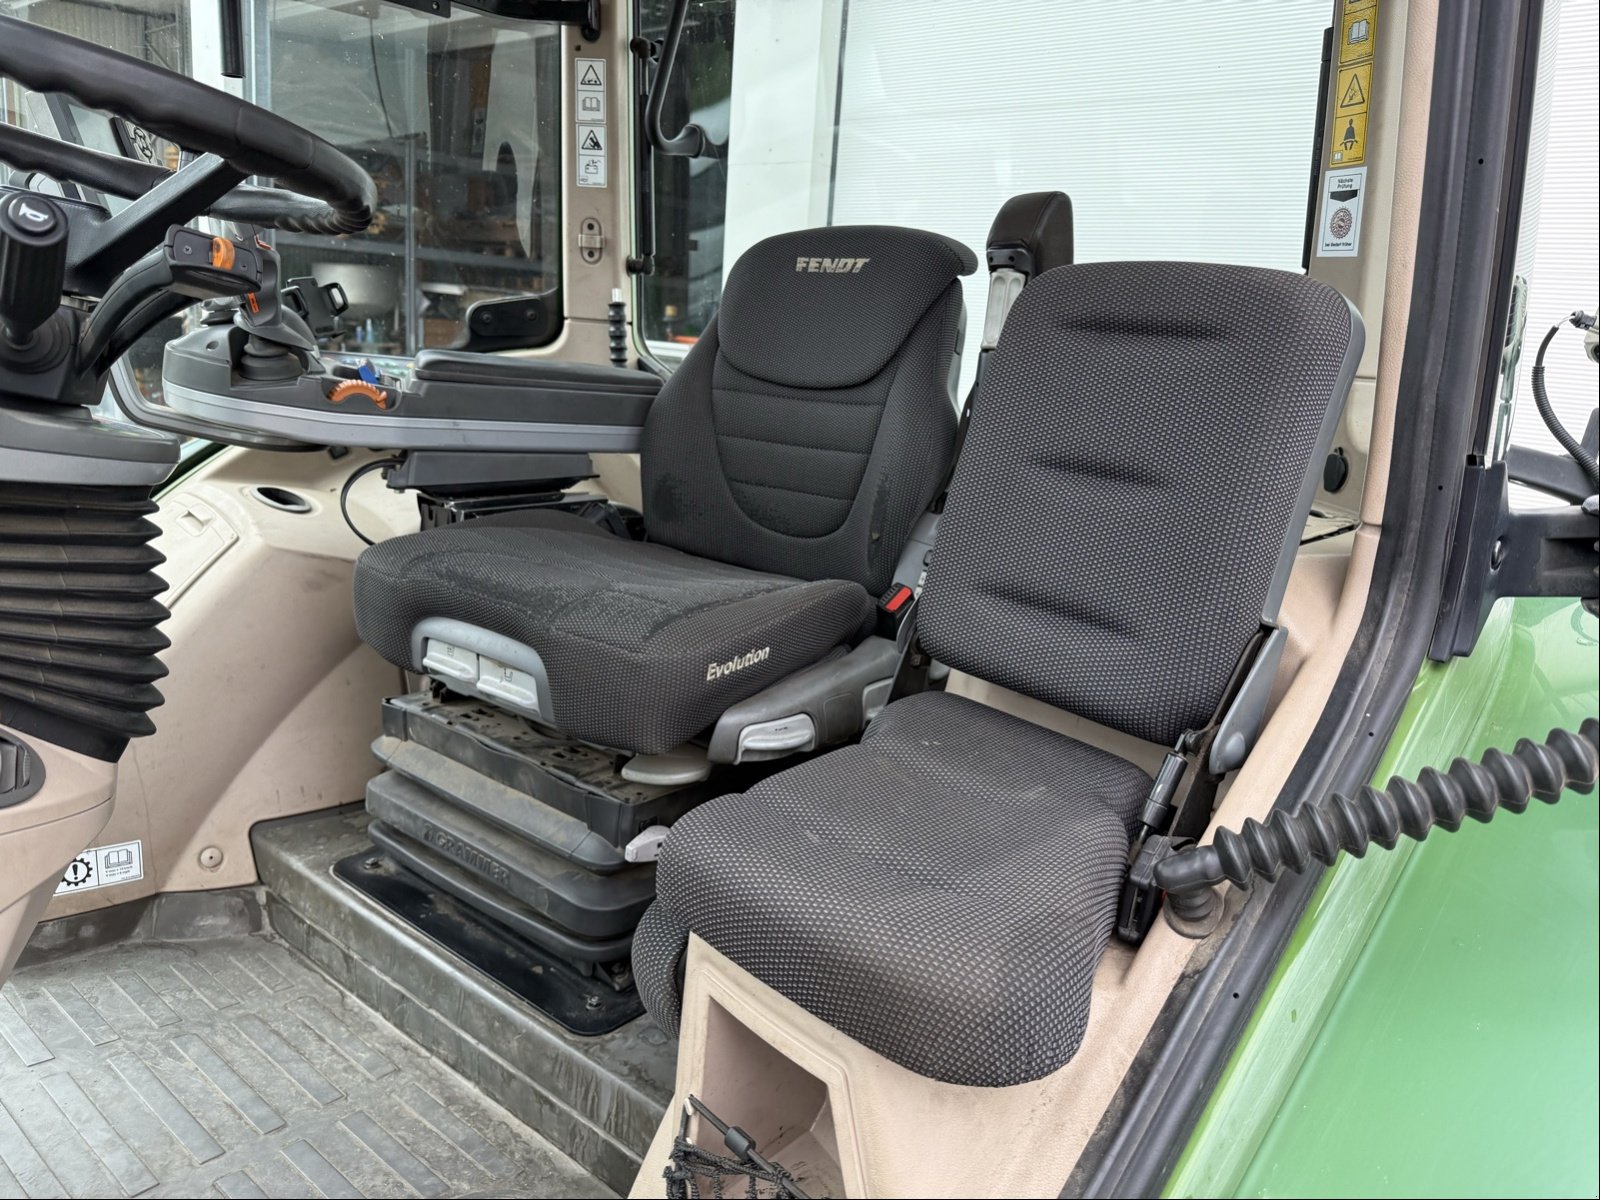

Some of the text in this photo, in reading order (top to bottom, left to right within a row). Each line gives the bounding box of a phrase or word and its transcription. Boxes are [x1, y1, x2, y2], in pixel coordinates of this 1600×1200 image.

[796, 257, 871, 273] FENDT
[707, 646, 770, 680] Evolution
[436, 831, 509, 886] GRAMMER
